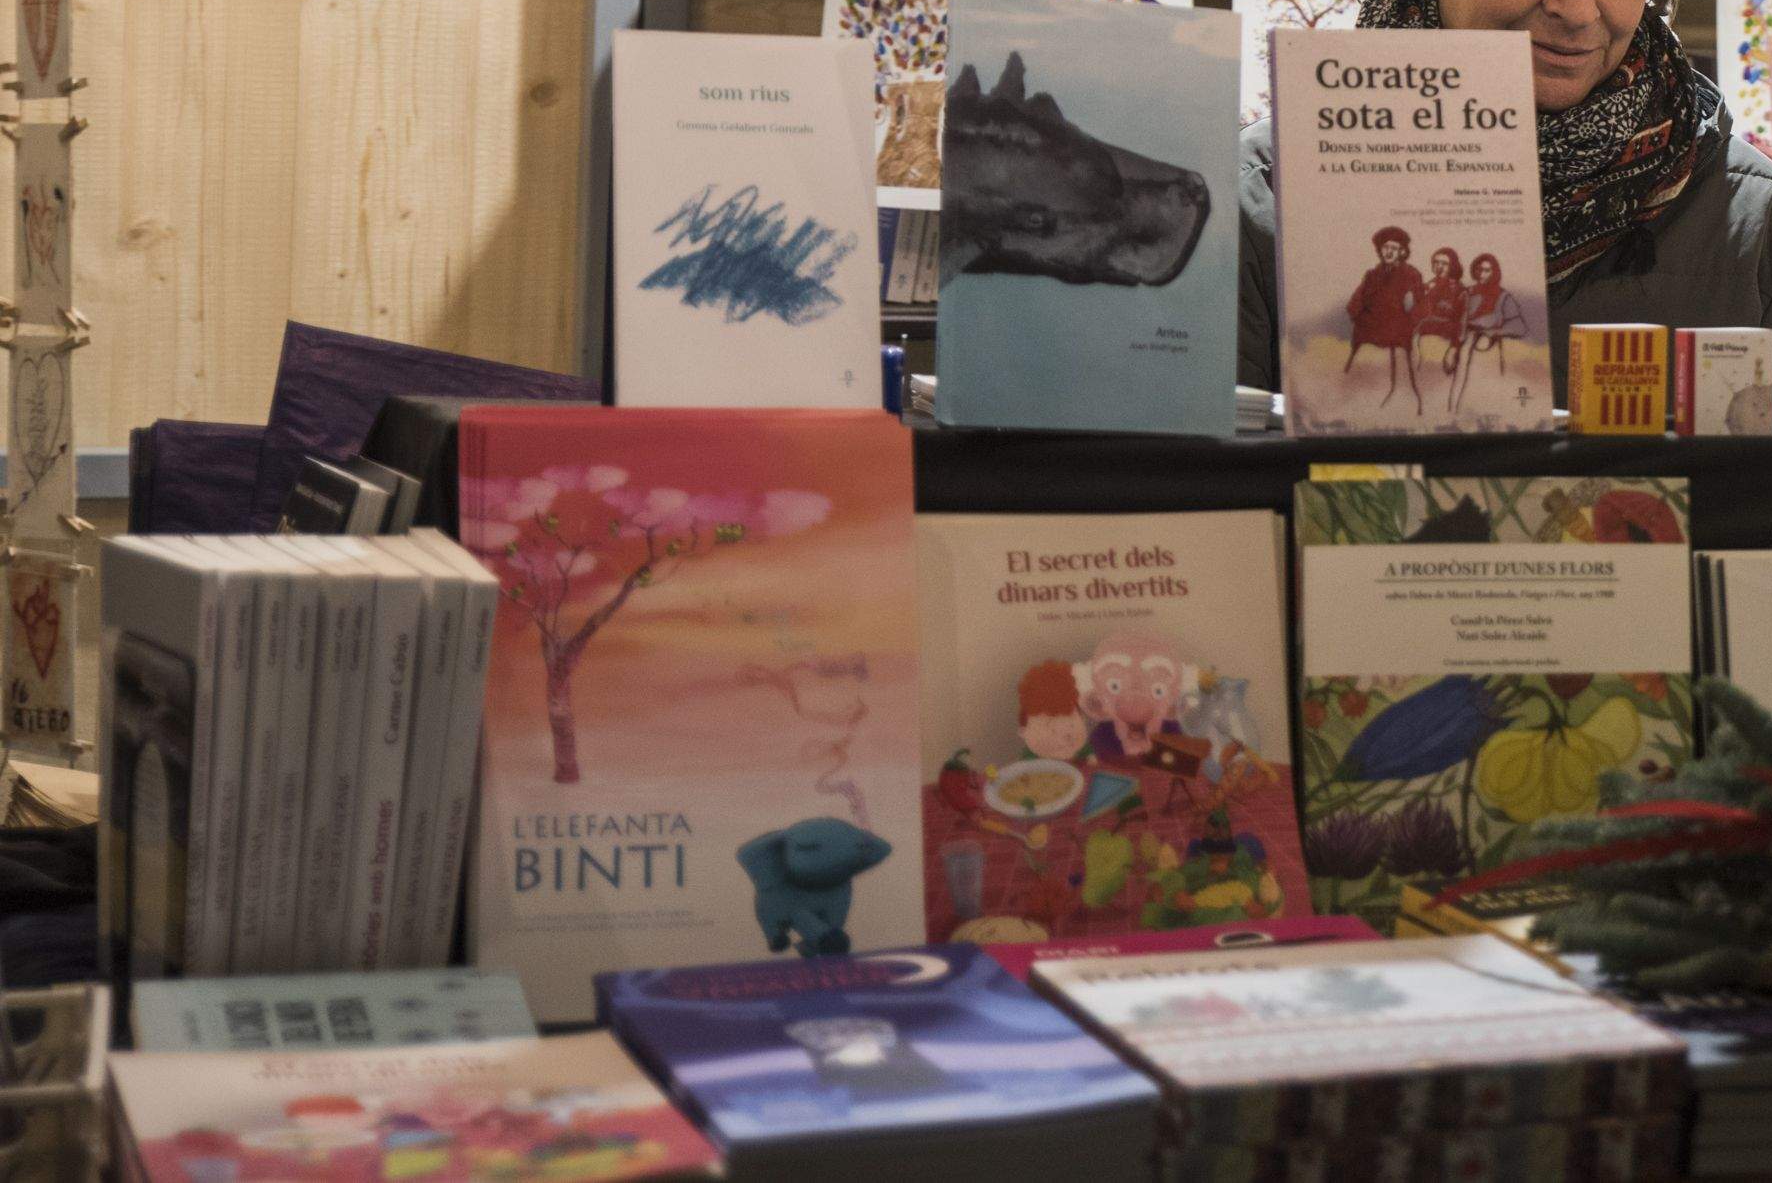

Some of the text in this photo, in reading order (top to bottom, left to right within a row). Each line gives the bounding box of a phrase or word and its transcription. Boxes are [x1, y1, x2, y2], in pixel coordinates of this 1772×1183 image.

[1315, 58, 1461, 97] Coratge
[699, 84, 790, 103] som rius
[1317, 98, 1517, 130] sota el foc
[1318, 140, 1482, 154] DONES NORD-AMERICANES
[1318, 159, 1515, 173] A LA GUERRA CIVIL ESPANYOLA
[1007, 545, 1175, 573] El secret dels
[1385, 559, 1615, 576] A PROPÒSIT D'UNES FLORS
[998, 576, 1190, 605] dinars divertits
[382, 690, 404, 745] Carme
[370, 799, 393, 865] homes
[514, 813, 693, 839] L'ELEFANTA
[515, 844, 685, 893] BINTI
